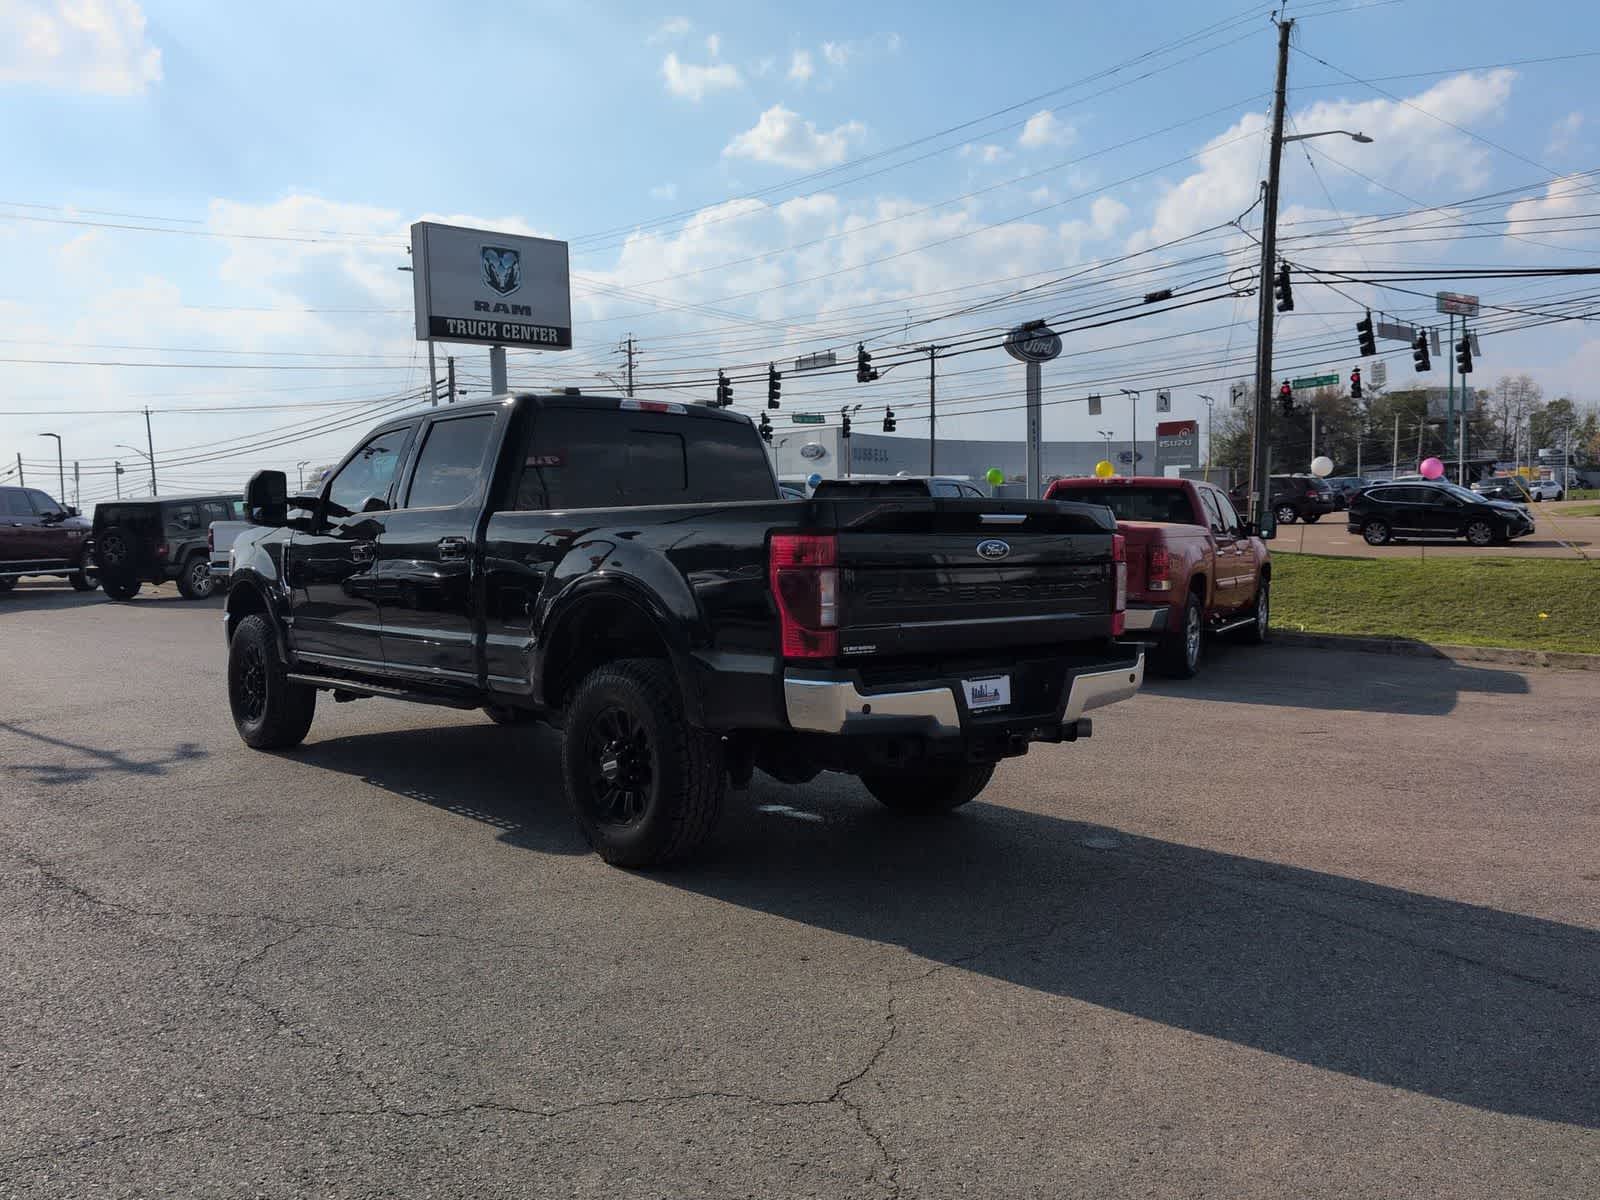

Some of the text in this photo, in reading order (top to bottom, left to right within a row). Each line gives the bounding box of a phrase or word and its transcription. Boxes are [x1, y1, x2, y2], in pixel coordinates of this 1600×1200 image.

[474, 300, 532, 317] RAM
[446, 318, 558, 343] TRUCK CENTER
[1159, 439, 1192, 448] ISUZU
